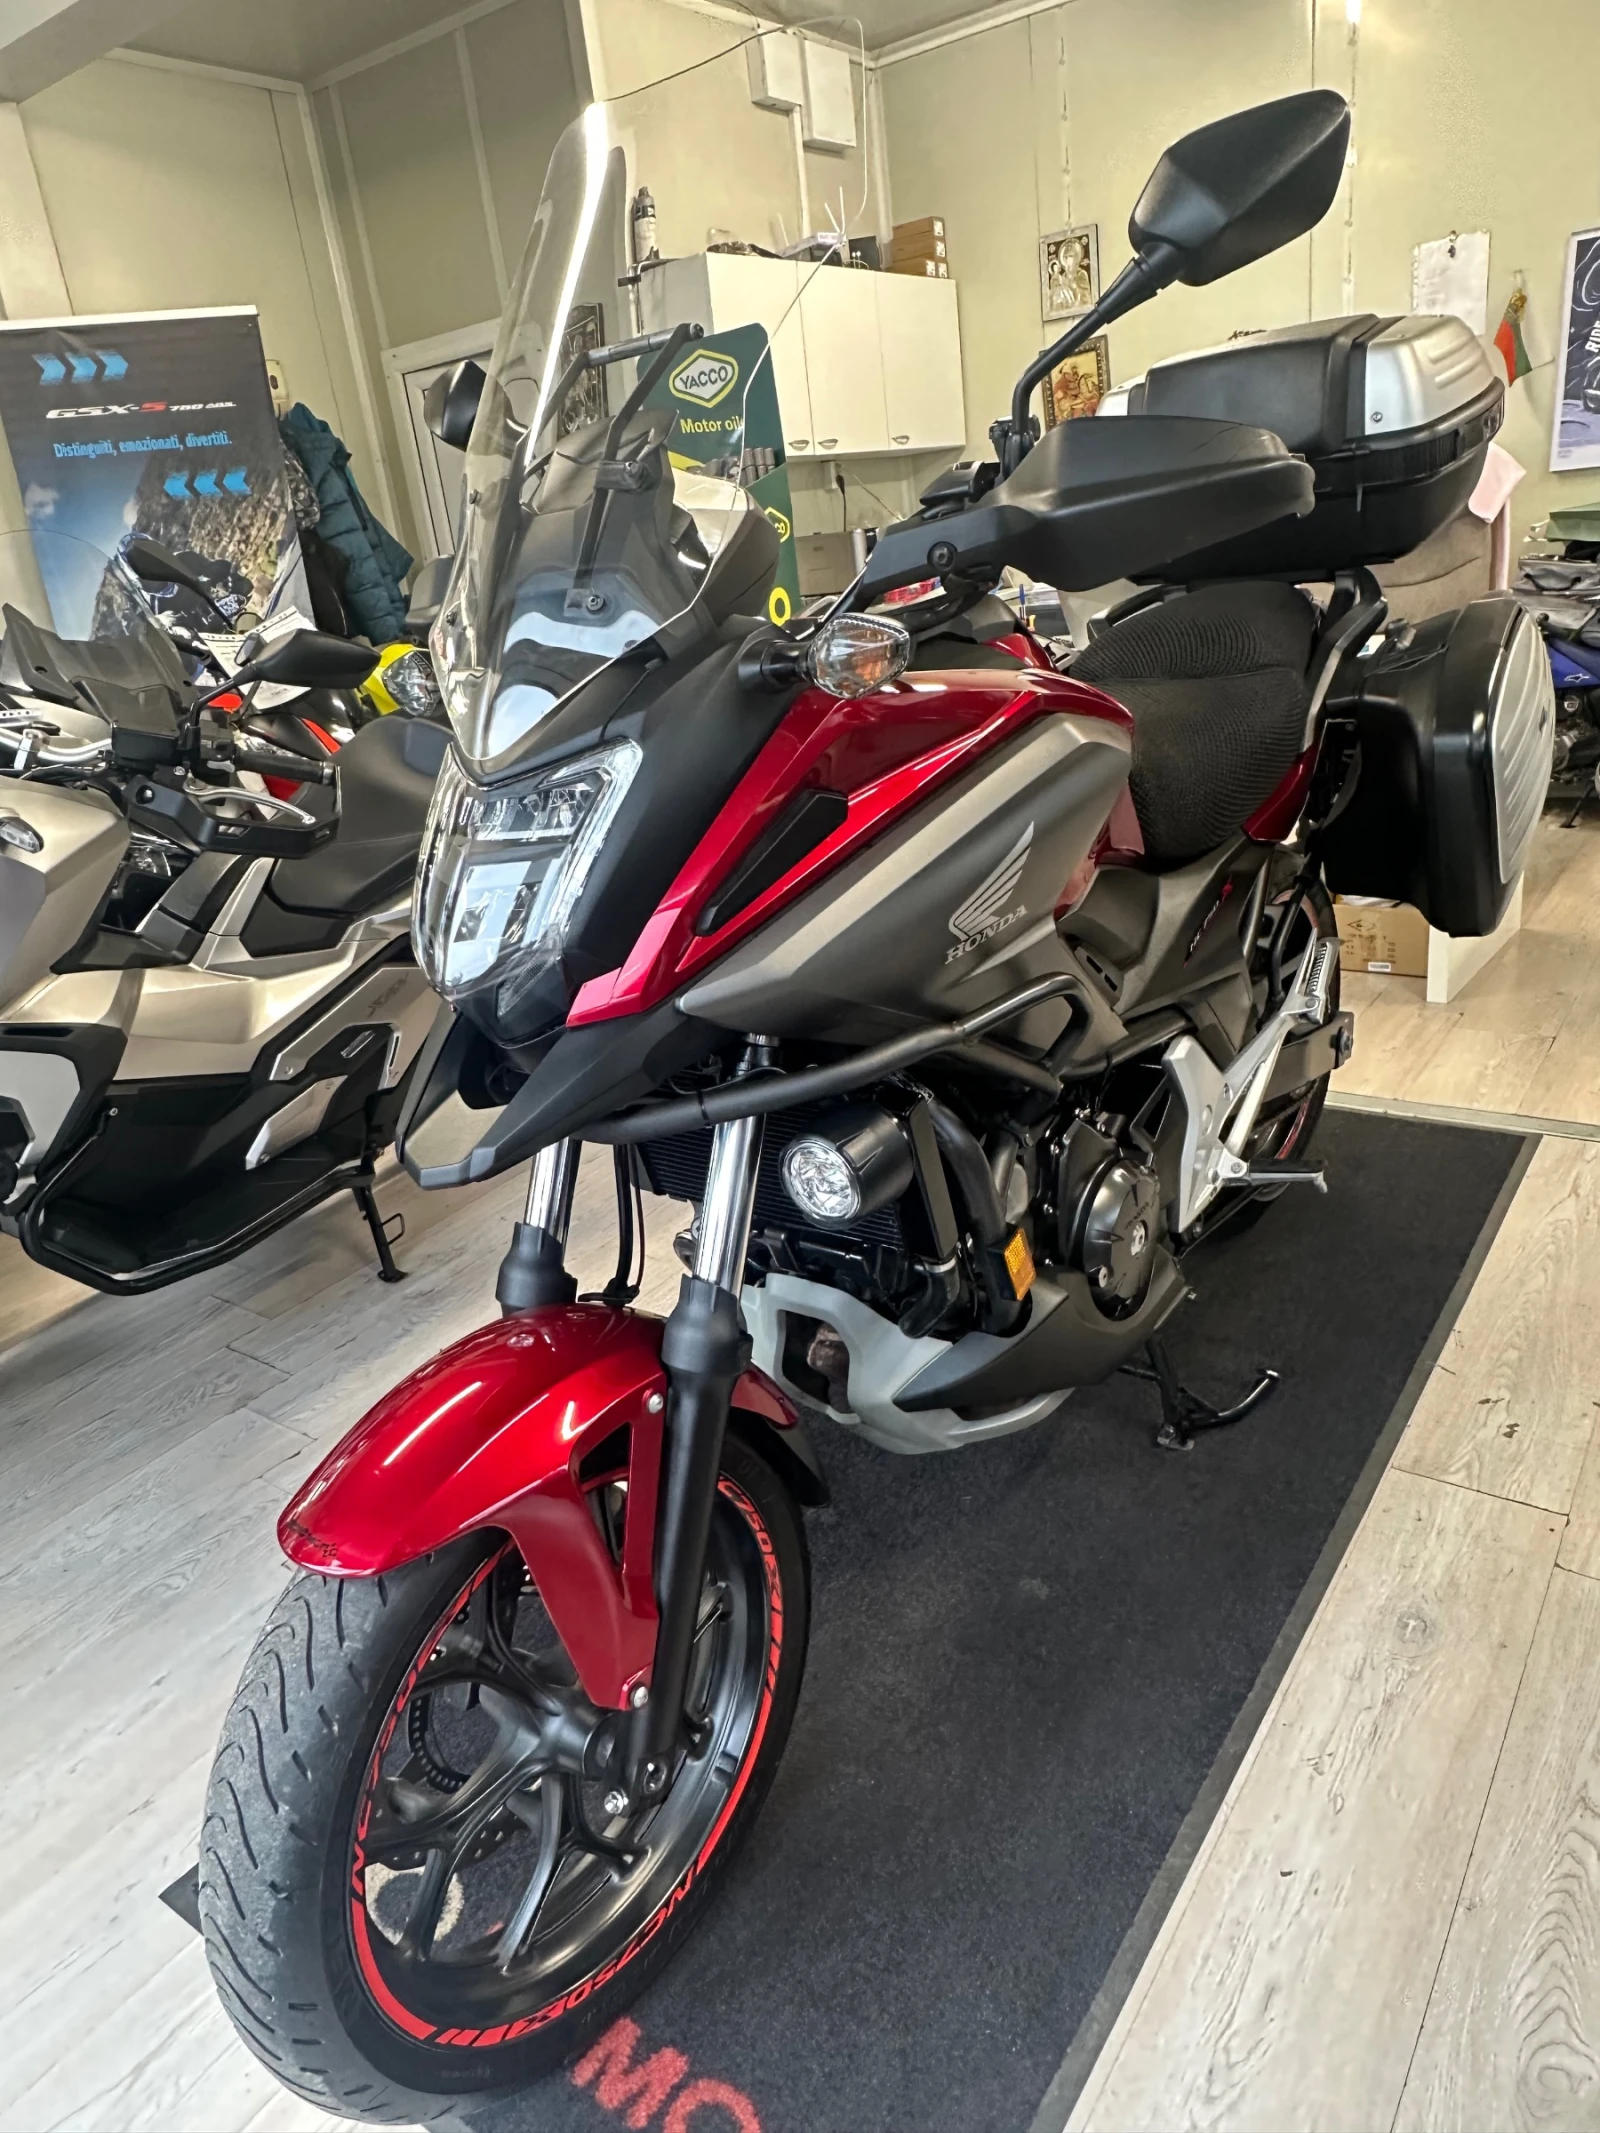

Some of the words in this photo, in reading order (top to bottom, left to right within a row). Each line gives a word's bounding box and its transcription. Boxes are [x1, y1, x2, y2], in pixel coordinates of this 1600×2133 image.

[680, 365, 729, 390] YACCO
[46, 402, 168, 419] GSX-S
[680, 418, 721, 434] Motor
[945, 905, 1027, 965] HONDA
[717, 1476, 783, 1608] C750X
